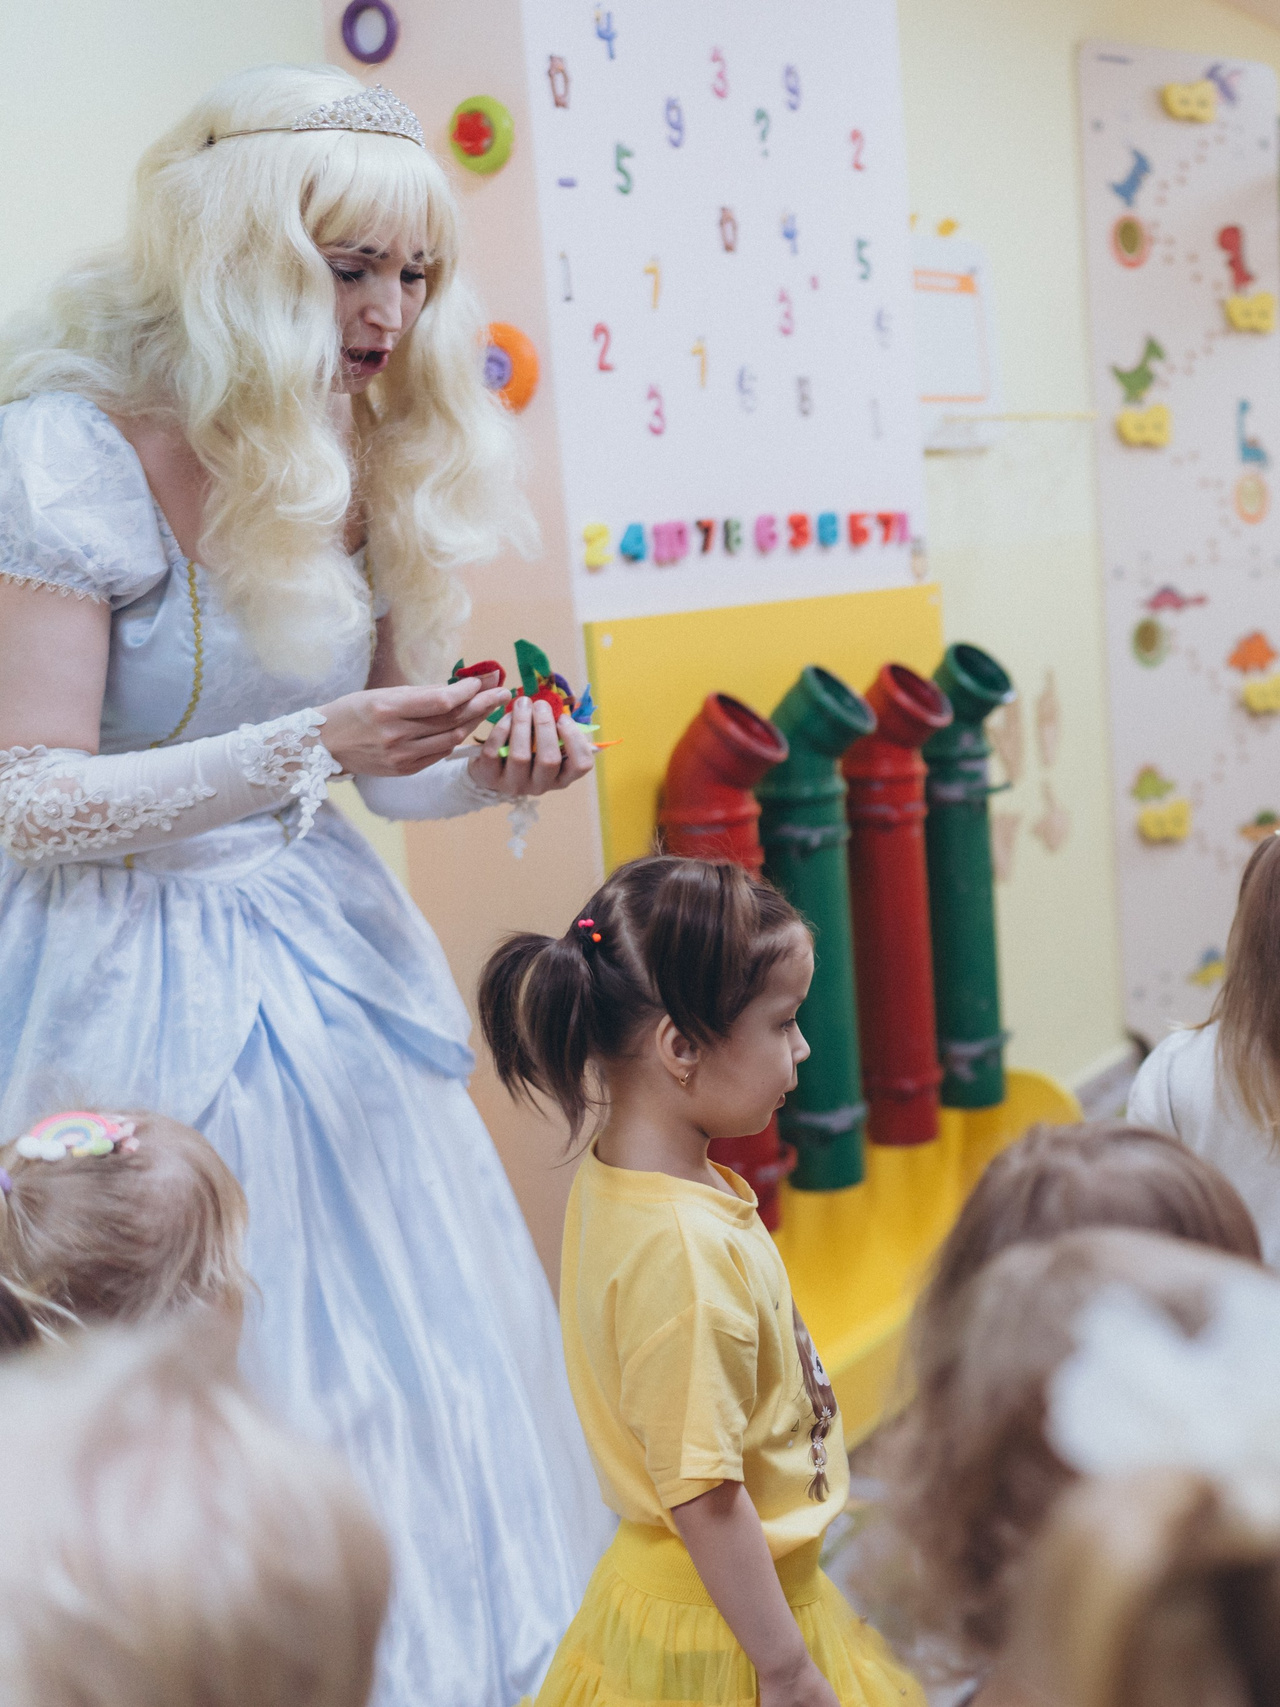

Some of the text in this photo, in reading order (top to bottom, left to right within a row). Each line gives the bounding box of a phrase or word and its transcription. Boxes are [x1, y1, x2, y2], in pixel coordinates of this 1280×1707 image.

[711, 46, 728, 98] 3
[665, 98, 684, 148] 9
[615, 143, 633, 194] 5
[593, 322, 614, 371] 2
[647, 383, 666, 435] 3
